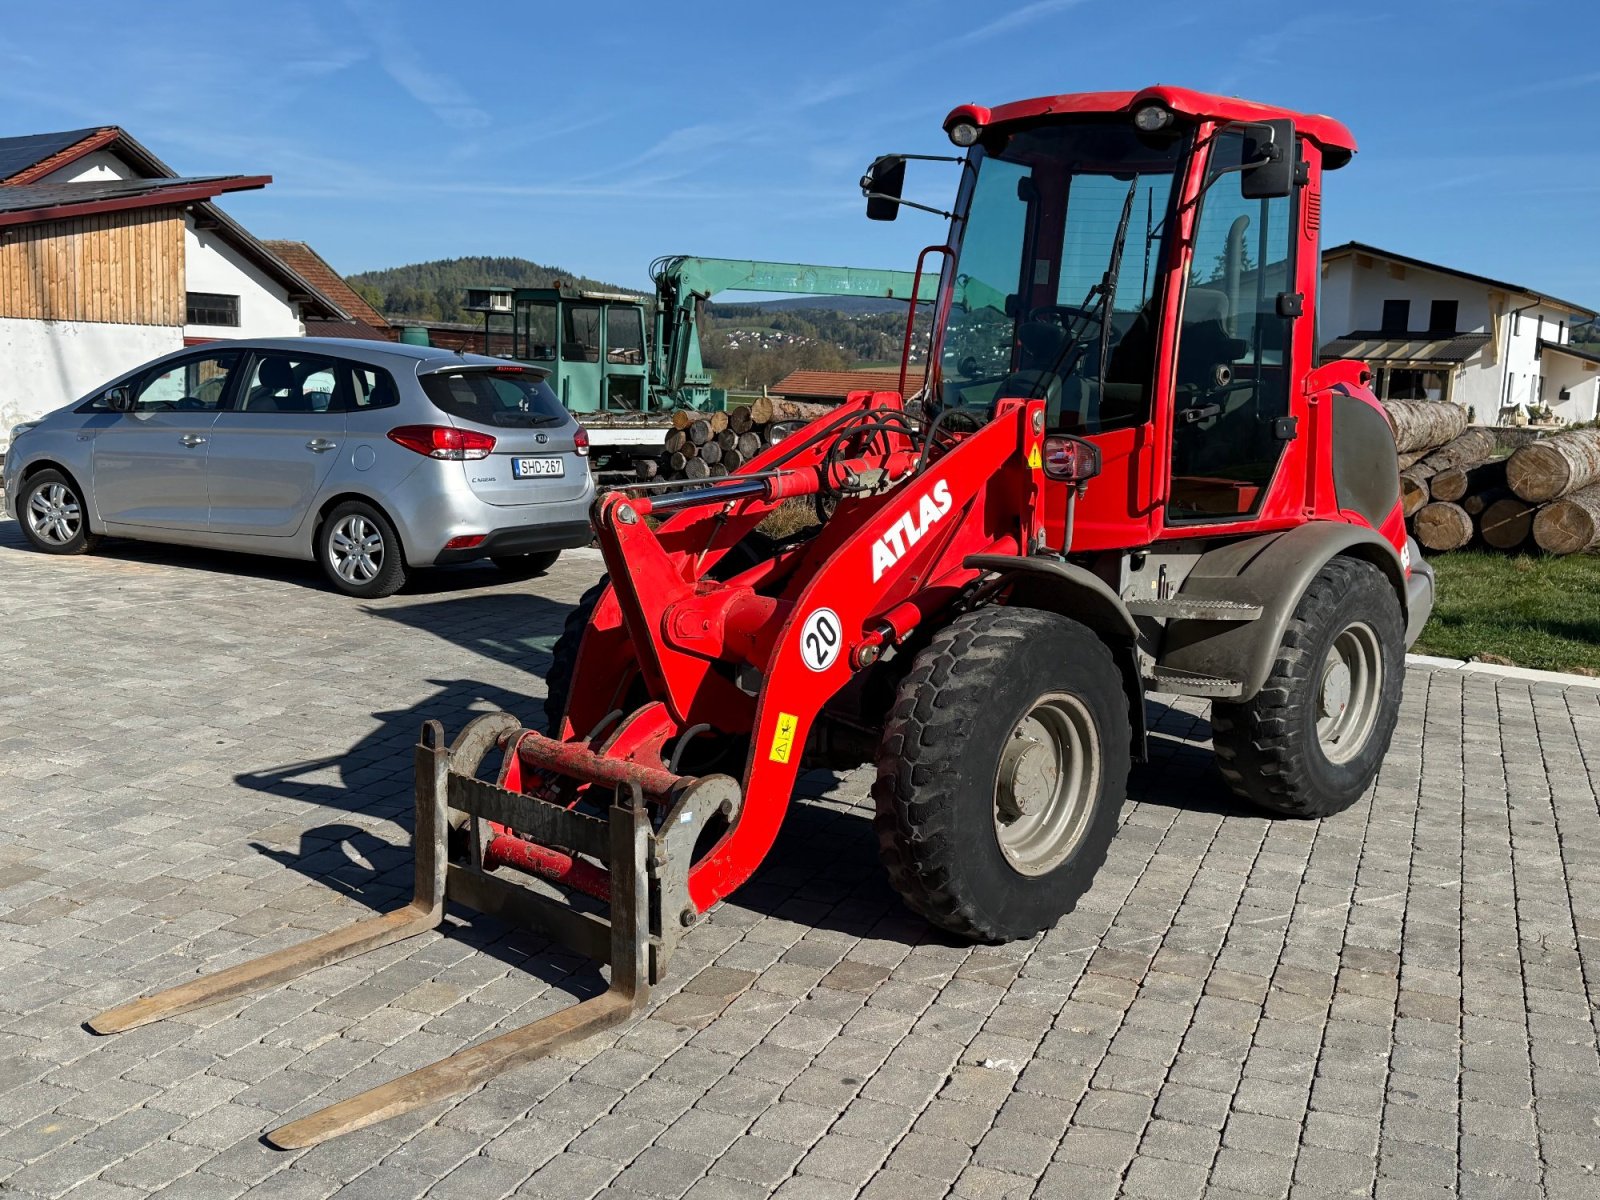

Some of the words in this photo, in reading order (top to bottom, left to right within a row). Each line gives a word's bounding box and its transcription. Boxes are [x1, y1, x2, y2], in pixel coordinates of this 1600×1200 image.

[521, 460, 561, 474] SHD-267
[871, 479, 953, 584] ATLAS
[805, 616, 837, 666] 20
